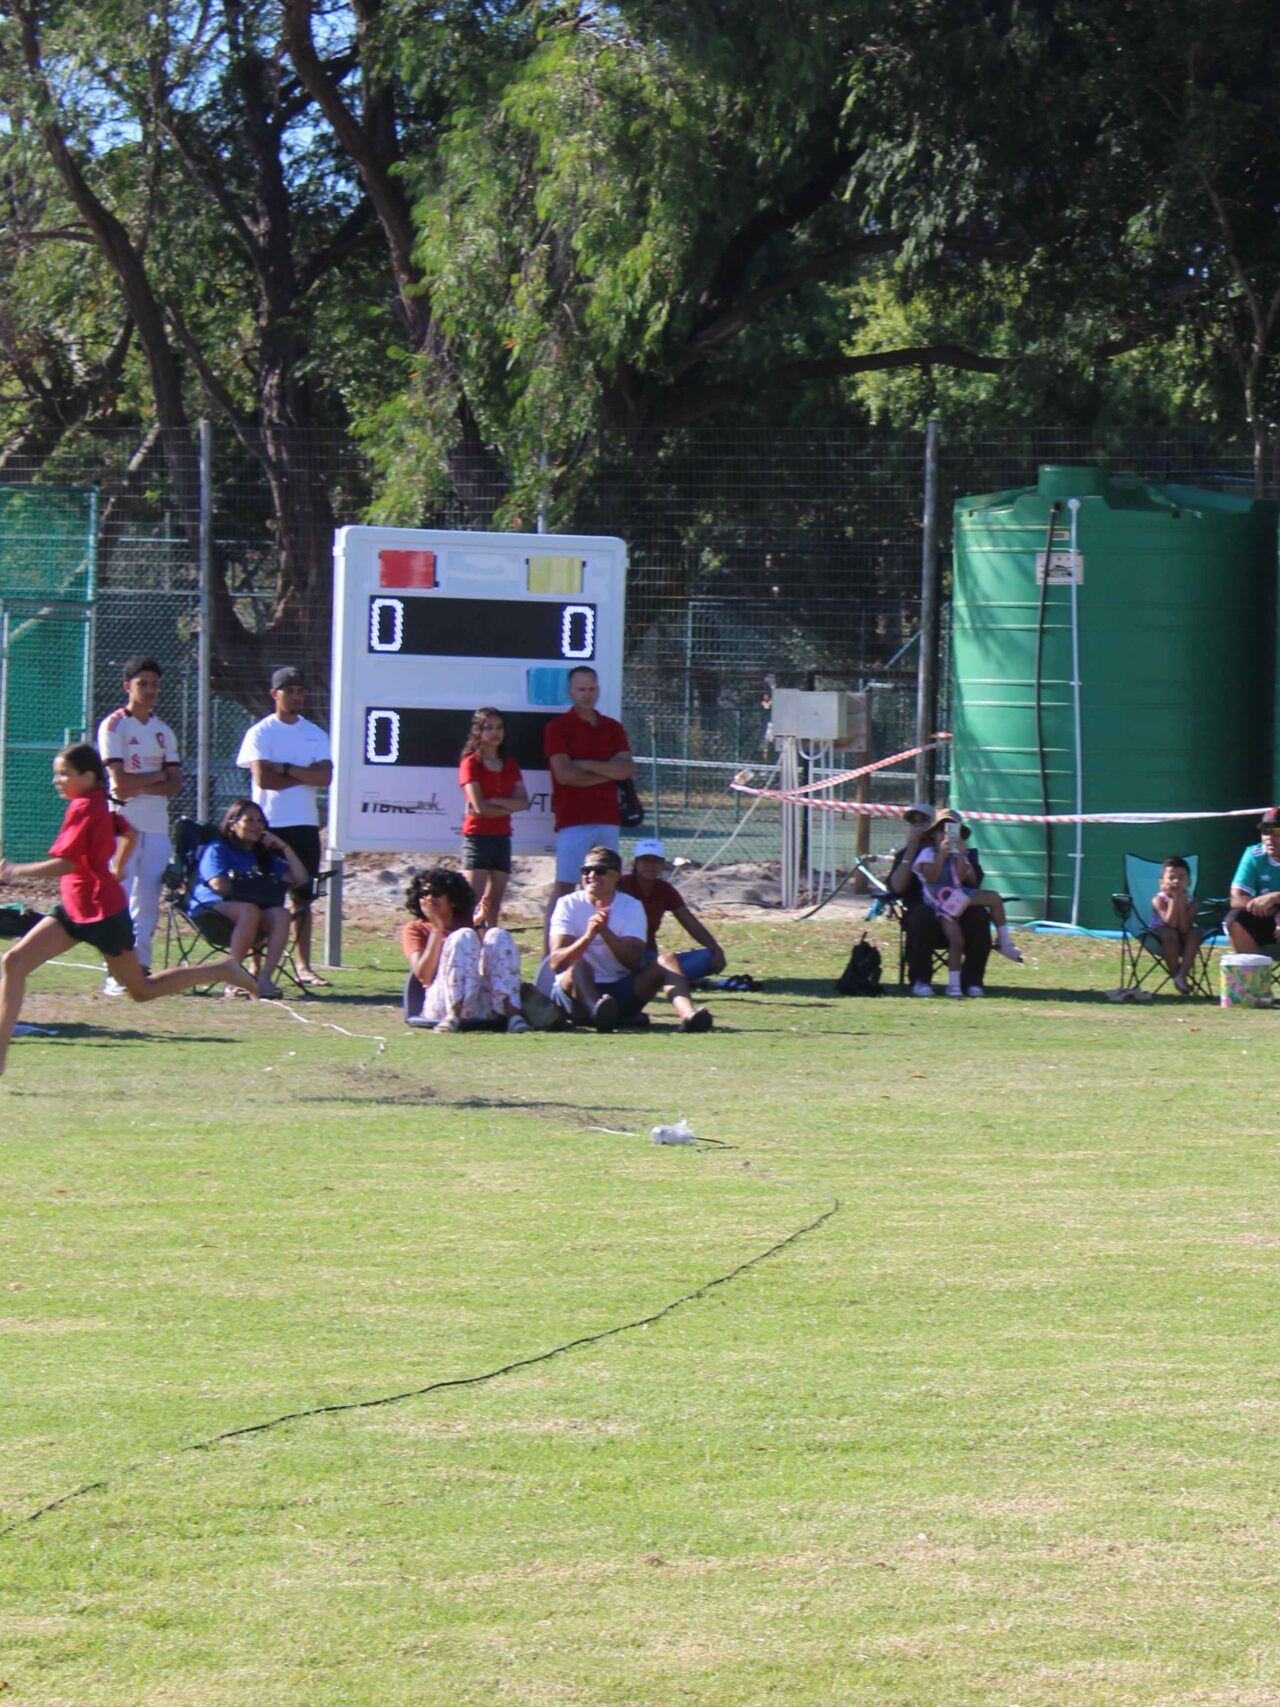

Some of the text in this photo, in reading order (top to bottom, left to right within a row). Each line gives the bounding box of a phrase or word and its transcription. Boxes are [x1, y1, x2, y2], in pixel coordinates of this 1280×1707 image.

[370, 598, 404, 651] 0
[562, 606, 595, 658] 0
[366, 710, 400, 763] 0
